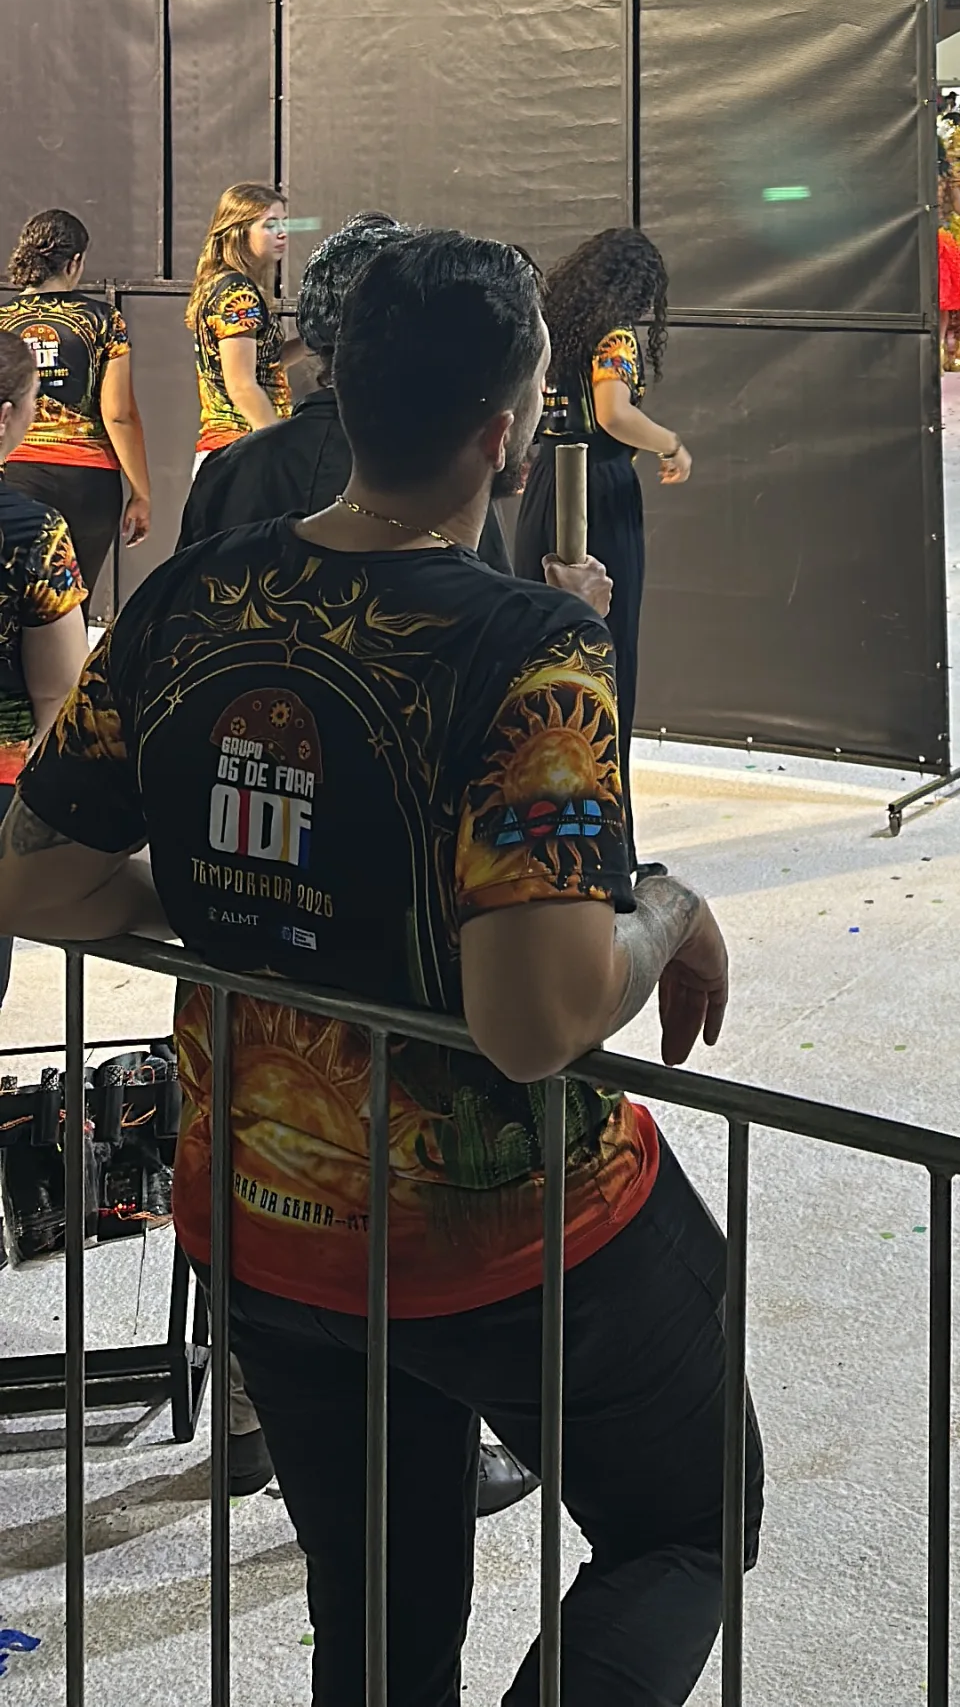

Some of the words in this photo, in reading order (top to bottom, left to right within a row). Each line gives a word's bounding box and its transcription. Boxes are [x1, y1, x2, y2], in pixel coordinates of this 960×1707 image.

[221, 736, 264, 760] GRUPO
[217, 755, 240, 783] OS
[244, 760, 269, 788] DE
[275, 766, 315, 798] FORA
[208, 783, 313, 867] ODF
[191, 858, 292, 905] TEMPORADA
[297, 884, 334, 919] 2026
[221, 910, 259, 926] ALMT
[260, 1188, 278, 1213] DA
